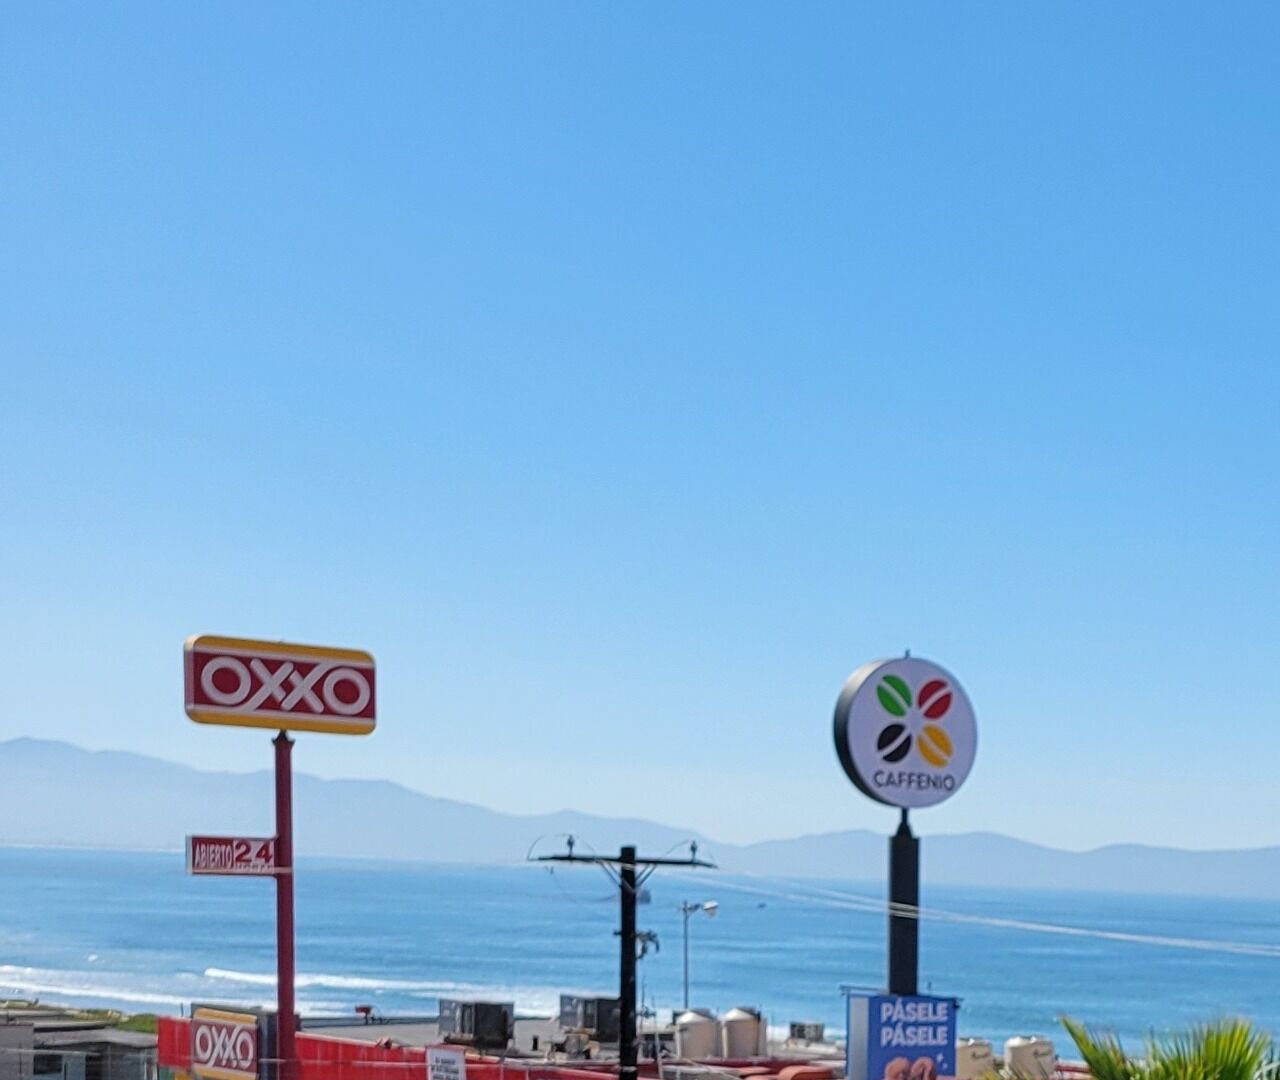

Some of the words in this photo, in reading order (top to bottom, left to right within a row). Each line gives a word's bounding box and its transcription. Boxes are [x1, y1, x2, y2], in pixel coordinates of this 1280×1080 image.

[201, 656, 371, 716] OXXO
[873, 770, 956, 791] CAFFENIO
[194, 843, 233, 868] ABIERTO
[234, 841, 273, 863] 24
[880, 999, 949, 1022] PÁSELE
[195, 1024, 254, 1069] OXXO
[880, 1022, 949, 1047] PÁSELE
